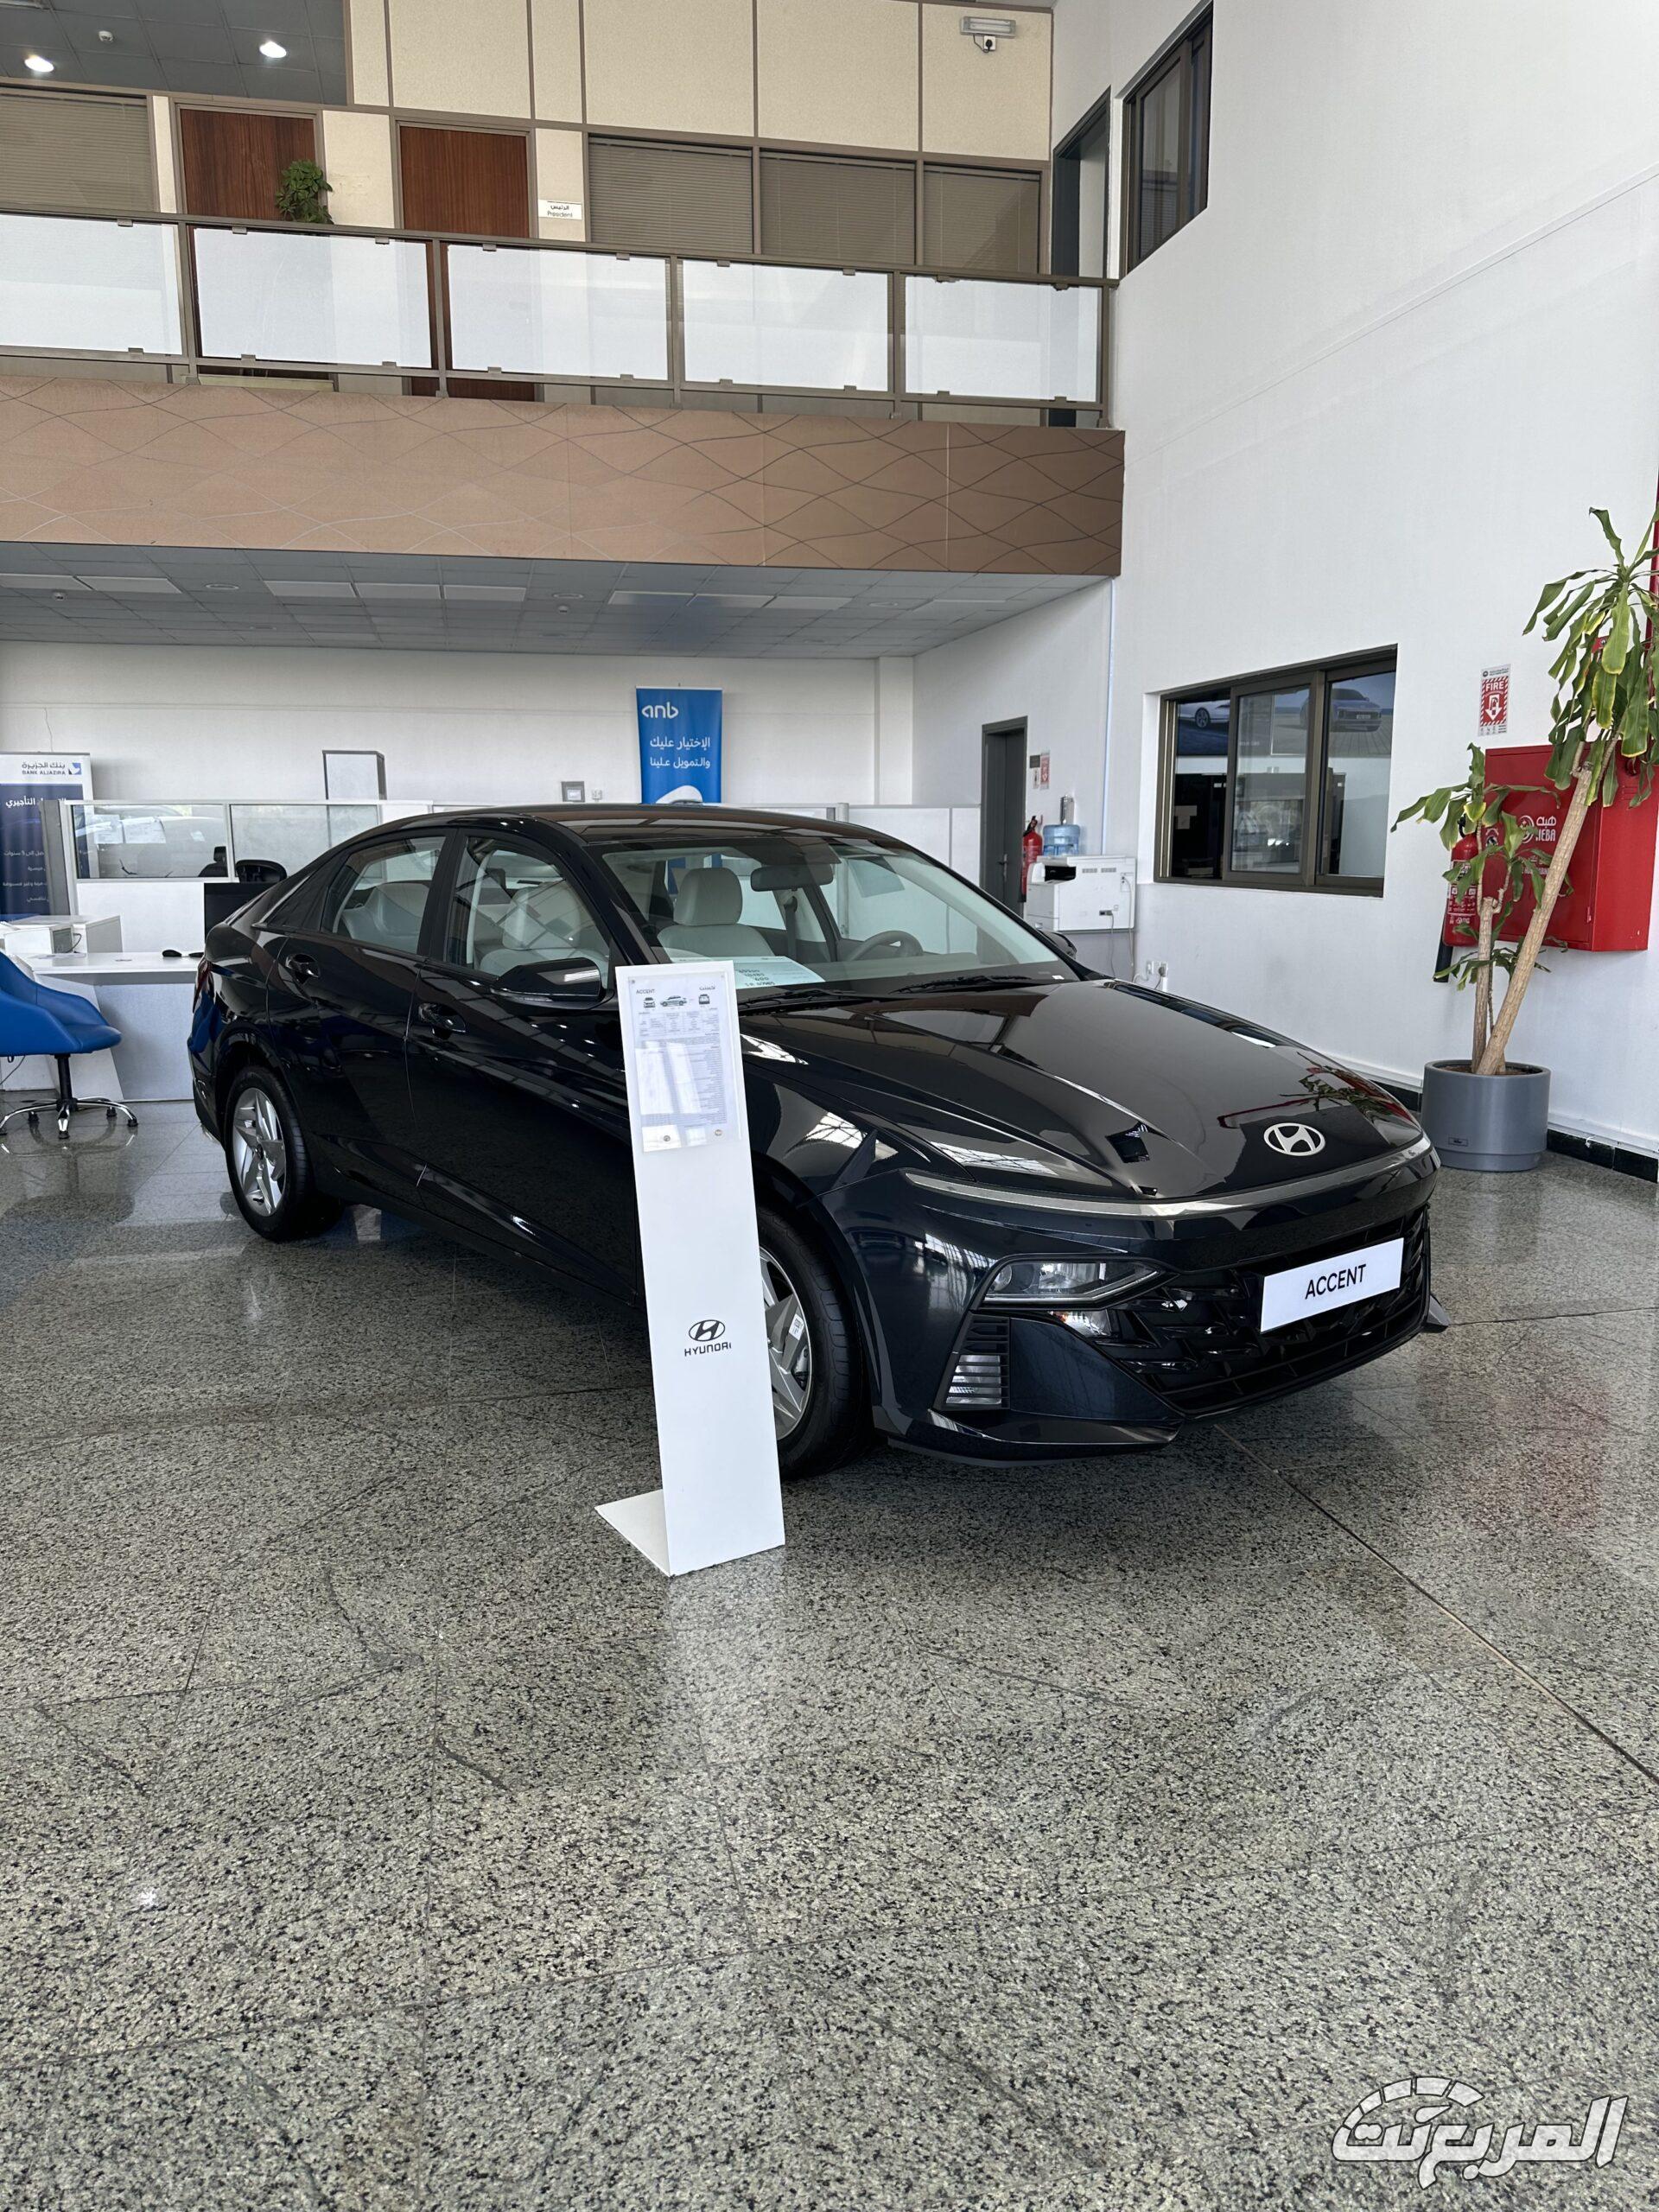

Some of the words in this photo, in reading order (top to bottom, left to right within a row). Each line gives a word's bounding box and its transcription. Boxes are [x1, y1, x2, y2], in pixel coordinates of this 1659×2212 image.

[1485, 681, 1504, 692] FIRE
[641, 701, 679, 719] anb
[650, 735, 675, 750] عليك
[22, 760, 48, 769] الجزيرة
[650, 756, 671, 769] علينا
[673, 757, 711, 770] والتمويل
[5, 796, 35, 809] التأجيري
[1304, 1263, 1367, 1300] ACCENT
[683, 1341, 732, 1357] HYUNDAI
